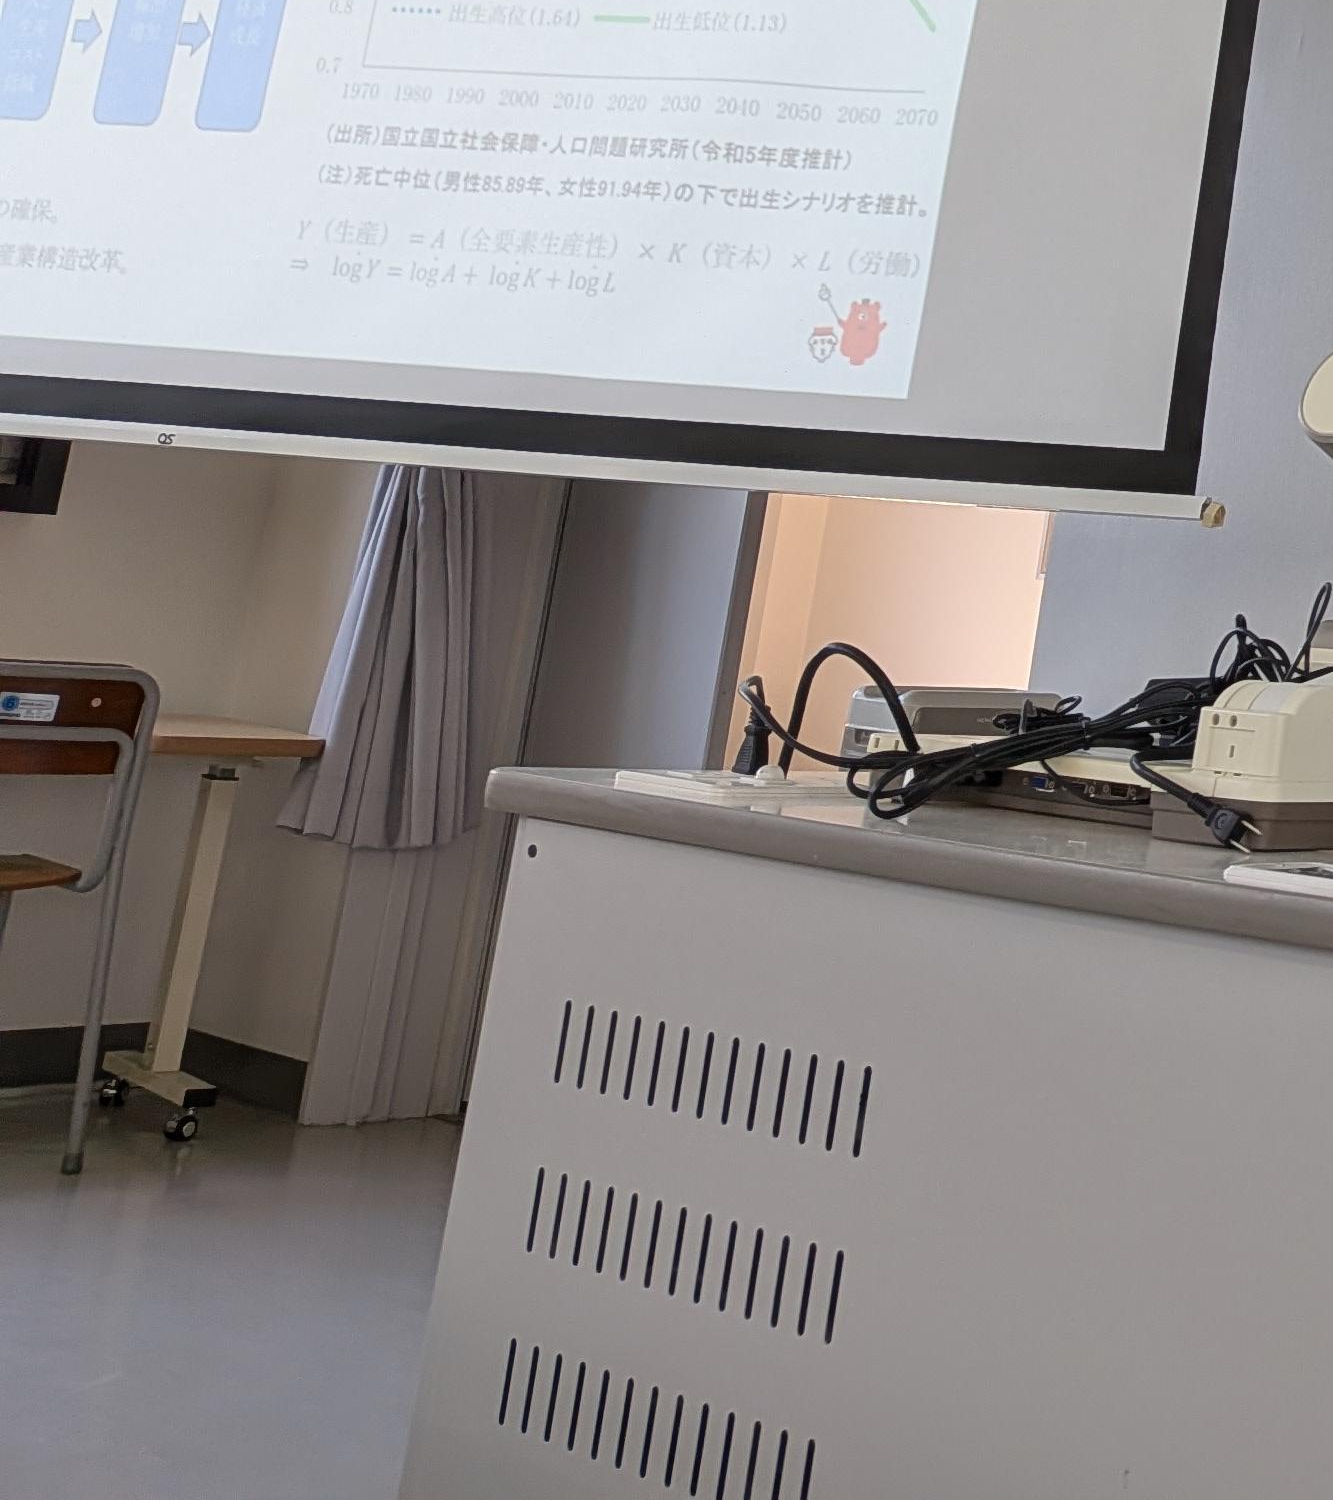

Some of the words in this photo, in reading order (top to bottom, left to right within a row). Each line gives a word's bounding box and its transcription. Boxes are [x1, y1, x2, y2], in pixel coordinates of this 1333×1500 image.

[316, 57, 342, 74] 0.7
[341, 82, 380, 102] 1970
[393, 84, 432, 104] 1980
[446, 86, 485, 106] 1990
[498, 88, 540, 109] 2000
[553, 91, 594, 111] 2010
[607, 93, 647, 113] 2020
[660, 94, 701, 114] 2030
[716, 95, 760, 117] 2040
[776, 100, 822, 122] 2050
[837, 104, 882, 125] 2060
[895, 106, 939, 127] 2070
